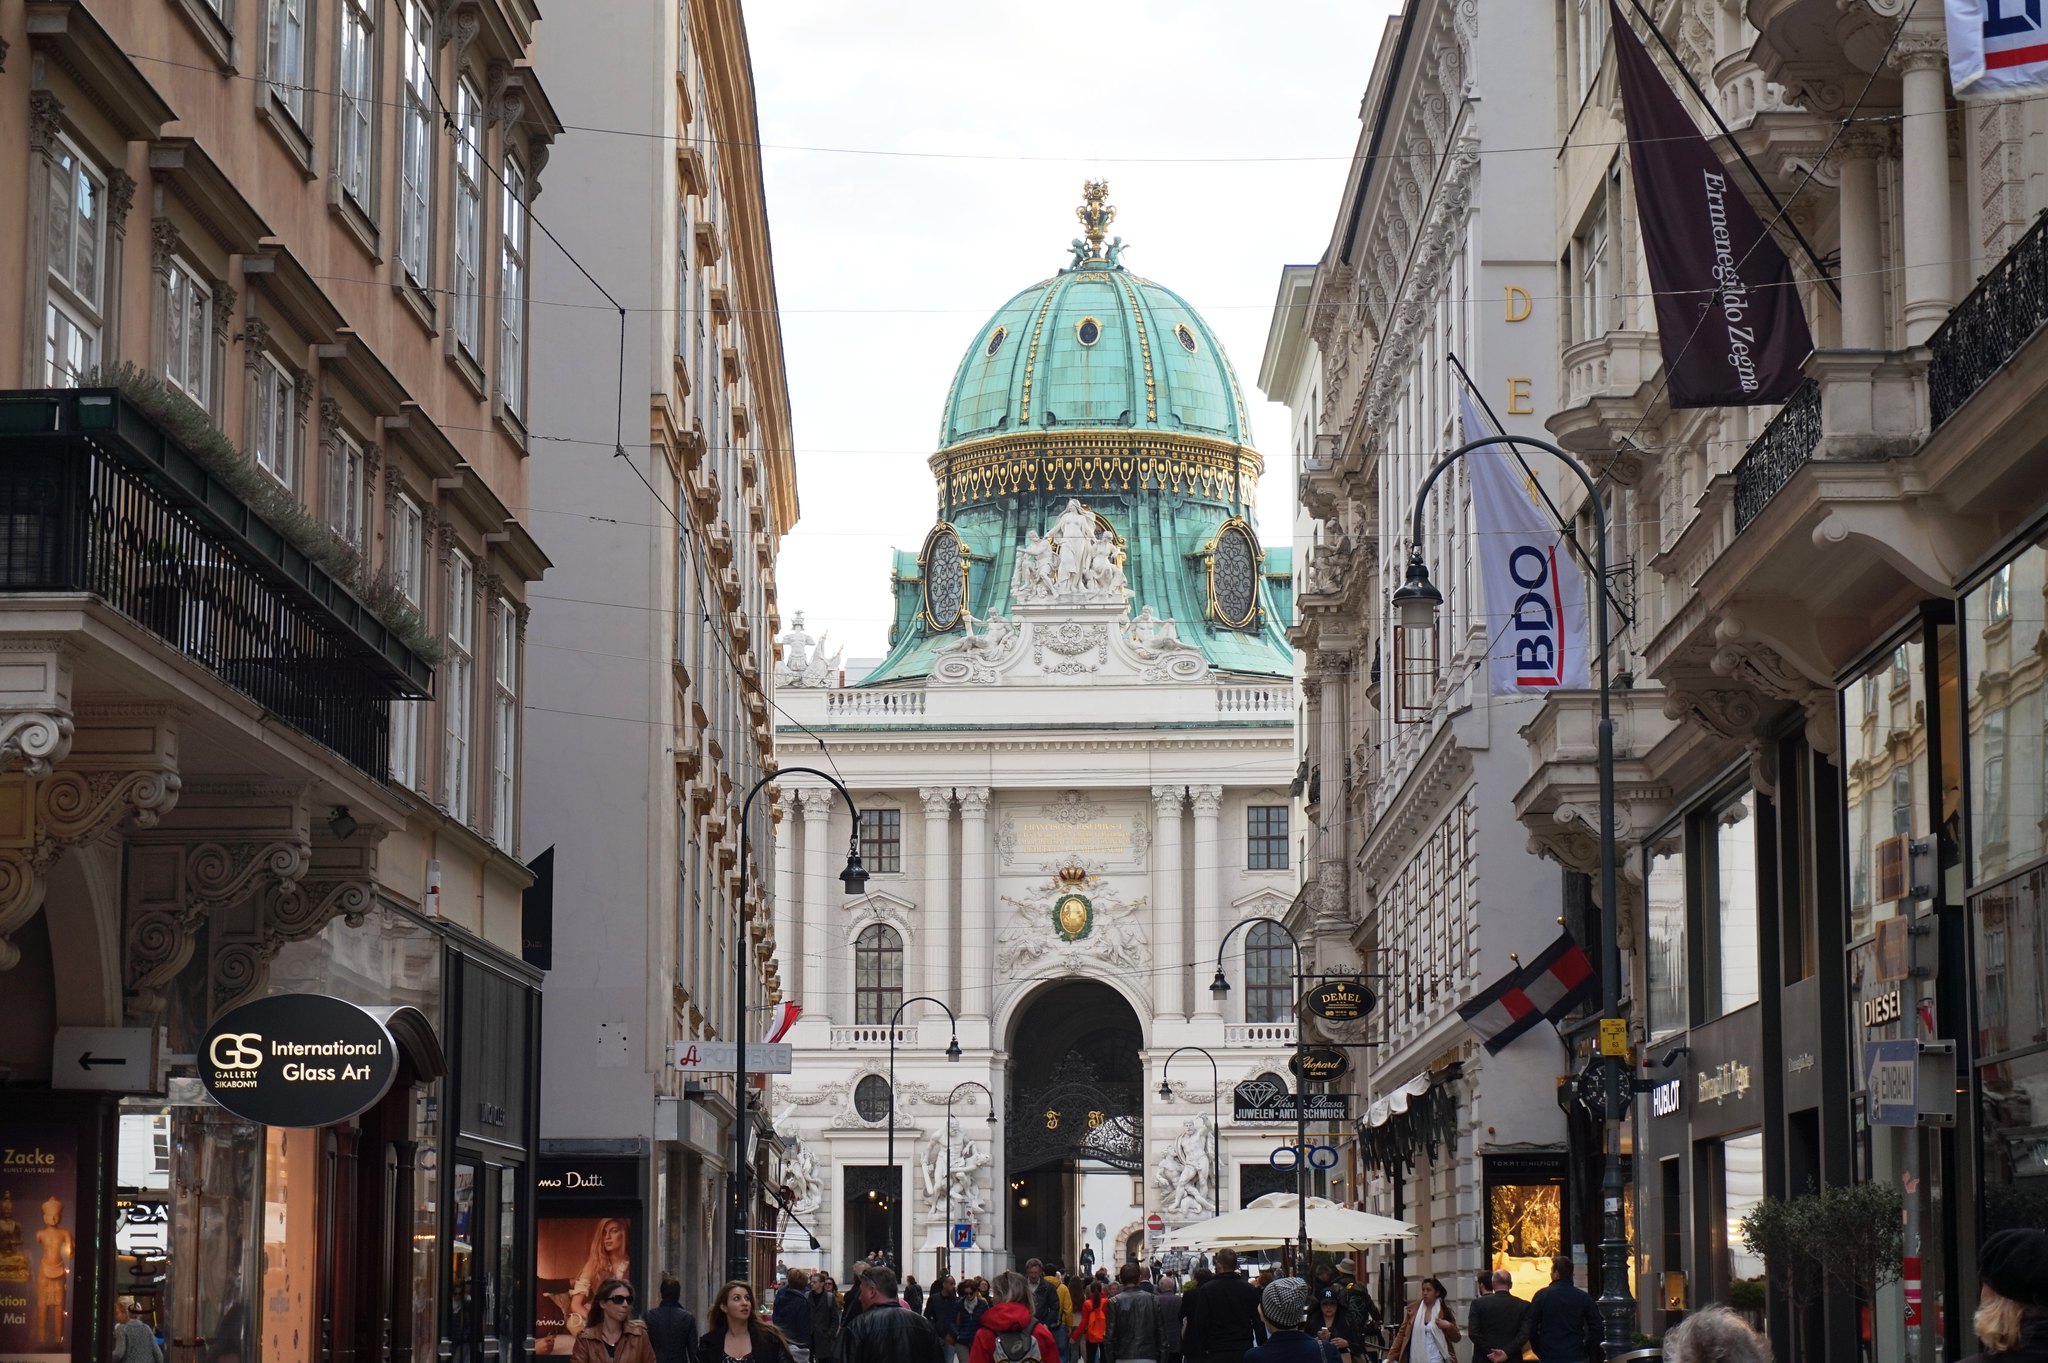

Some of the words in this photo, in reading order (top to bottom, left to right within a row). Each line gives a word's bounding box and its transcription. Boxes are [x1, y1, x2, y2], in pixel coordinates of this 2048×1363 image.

[1703, 168, 1748, 322] Ermenegildo
[1727, 325, 1759, 393] Zegna
[1509, 545, 1554, 671] BDO
[1321, 993, 1361, 1003] DEMEL
[271, 1039, 382, 1056] International
[215, 1071, 258, 1079] GALLERY
[282, 1063, 336, 1082] Glass
[341, 1064, 371, 1081] Art
[214, 1080, 258, 1088] SIKABONYI
[1881, 1066, 1913, 1099] EINBAHN
[1269, 1095, 1295, 1108] Kiss
[1653, 1080, 1680, 1117] HUBLOT
[1236, 1109, 1275, 1119] JUWELEN
[4, 1147, 56, 1165] Zacke
[565, 1171, 605, 1189] Dutti
[3, 1313, 26, 1324] Mai
